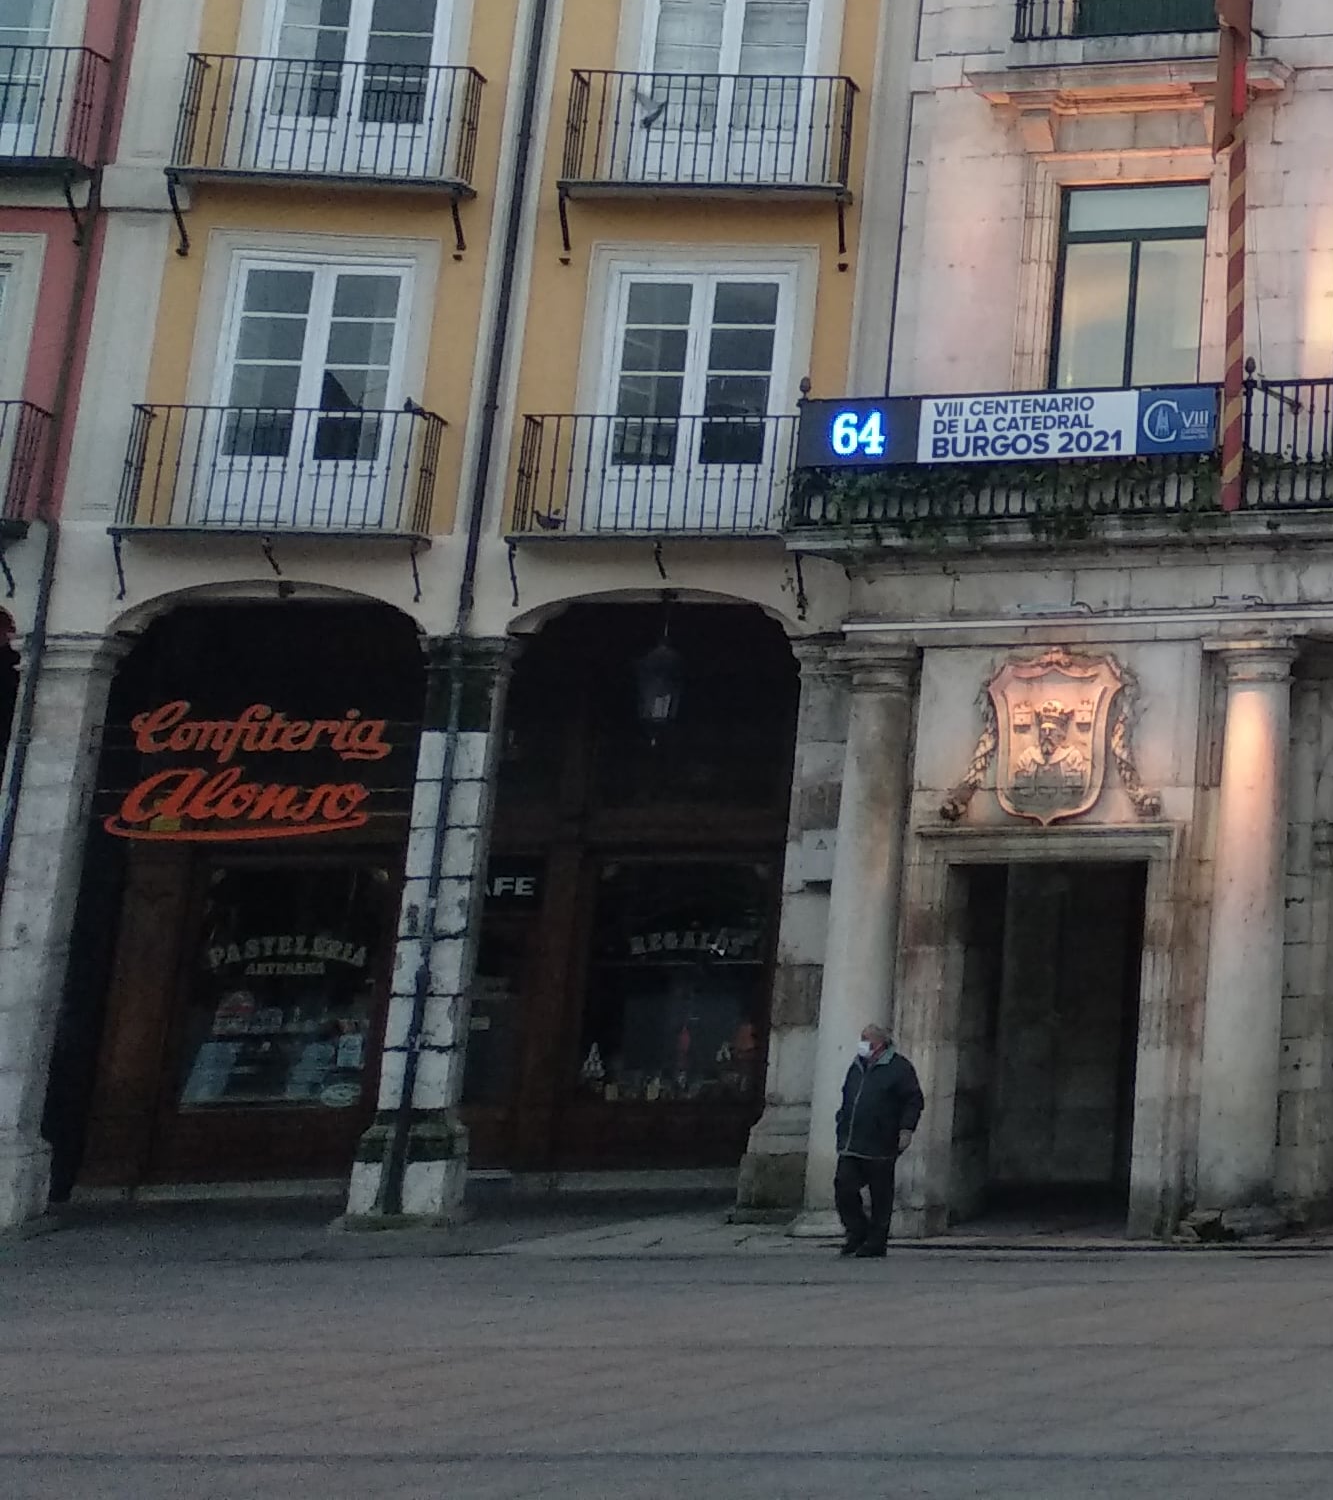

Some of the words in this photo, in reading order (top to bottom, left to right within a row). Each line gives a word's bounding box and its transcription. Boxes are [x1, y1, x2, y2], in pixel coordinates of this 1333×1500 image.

[934, 401, 964, 417] VIII
[969, 396, 1095, 416] CENTENARIO
[832, 411, 886, 454] 64
[933, 418, 958, 435] DE
[964, 417, 988, 434] LA
[993, 413, 1094, 432] CATEDRAL
[931, 433, 1050, 459] BURGOS
[1057, 429, 1122, 453] 2021
[119, 766, 371, 824] Alonso
